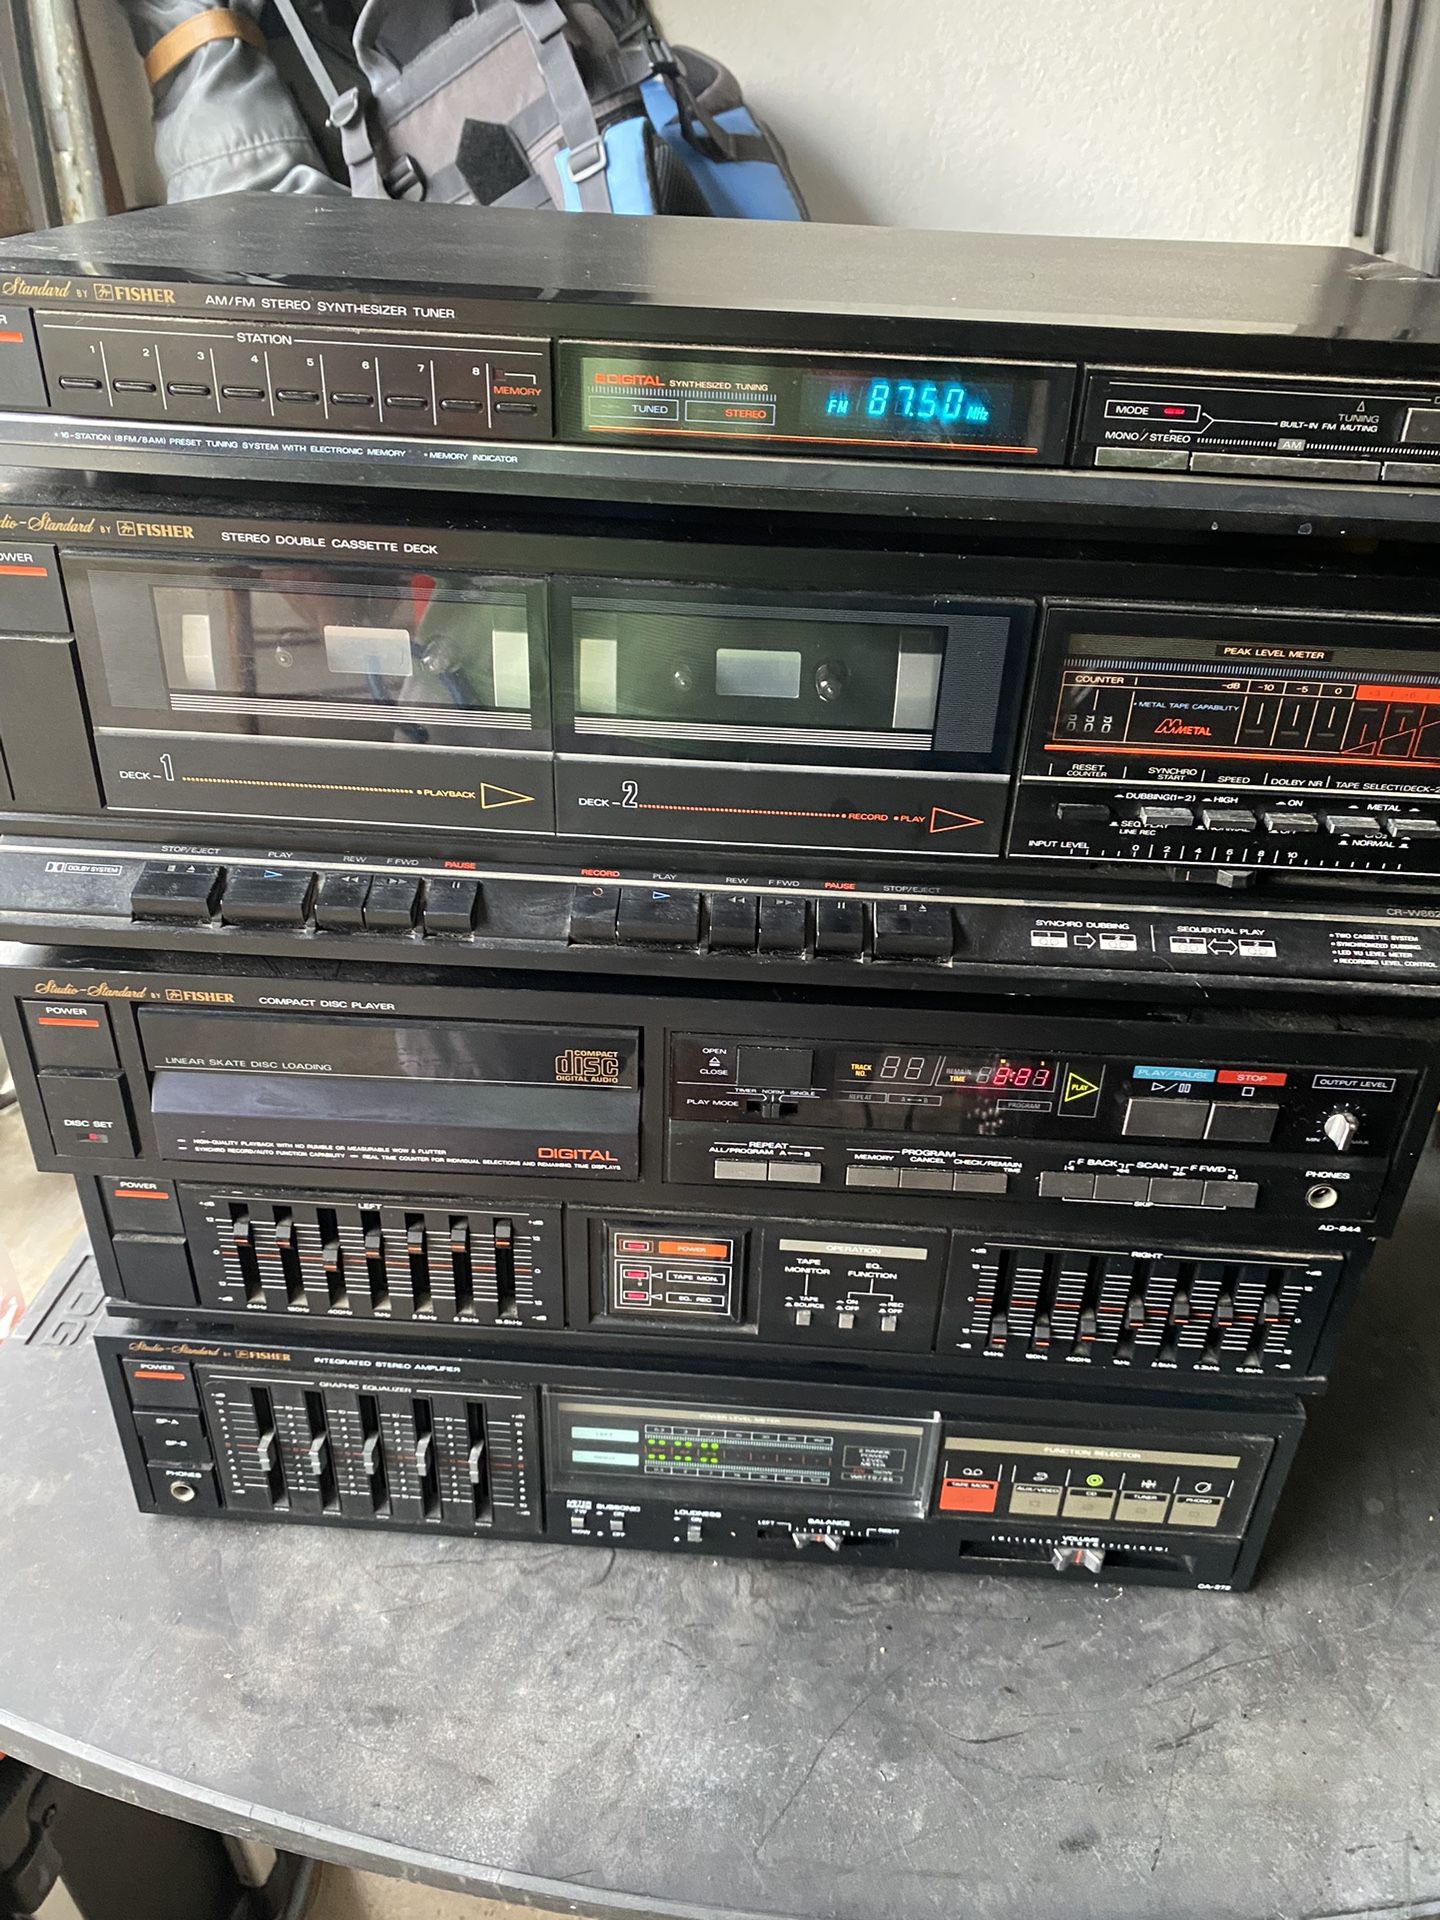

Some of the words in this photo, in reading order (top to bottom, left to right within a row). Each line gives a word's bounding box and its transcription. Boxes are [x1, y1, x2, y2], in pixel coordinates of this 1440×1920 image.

[76, 289, 87, 298] BY
[114, 286, 176, 304] FISHER
[205, 294, 255, 308] AM/FM
[261, 298, 311, 311] STEREO
[317, 301, 407, 317] SYNTHESIZER
[413, 307, 455, 319] TUNER
[237, 332, 292, 345] STATION
[90, 345, 96, 353] 1
[142, 348, 150, 357] 2
[197, 352, 205, 360] 3
[250, 355, 259, 363] 4
[306, 358, 314, 367] 5
[361, 360, 370, 370] 6
[417, 363, 425, 373] 7
[472, 366, 480, 376] 8
[606, 373, 665, 388] DIGITAL
[669, 379, 732, 390] SYNTHESIZED
[735, 383, 769, 392] TUNING
[493, 385, 542, 397] MEMORY
[868, 385, 965, 418] 87.50
[632, 404, 669, 415] TUNED
[725, 408, 767, 420] STEREO
[1115, 405, 1149, 416] MODE
[1338, 413, 1380, 424] TUNING
[1280, 420, 1319, 430] BUILT-IN
[1322, 422, 1337, 431] FM
[1340, 423, 1378, 433] MUTING
[1105, 429, 1191, 444] MONO/STEREO
[169, 438, 201, 447] PRESET
[205, 440, 238, 449] TUNING
[242, 441, 279, 451] SYSTEM
[282, 444, 306, 452] WITH
[310, 445, 363, 456] ELECTRONIC
[367, 448, 406, 457] MEMORY
[1282, 440, 1302, 450] AM
[430, 451, 468, 461] MEMORY
[473, 453, 518, 464] INDICATOR
[0, 512, 95, 534] dio-Standard
[100, 525, 111, 534] BY
[136, 523, 194, 539] FISHER
[221, 532, 271, 544] STEREO
[275, 535, 326, 548] DOUBLE
[331, 539, 399, 552] CASSETTE
[403, 543, 439, 555] DECK
[0, 552, 33, 563] OWER
[1224, 647, 1252, 657] PEAK
[1255, 649, 1286, 658] LEVEL
[1289, 650, 1325, 660] METER
[1075, 675, 1124, 685] COUNTER
[1192, 703, 1240, 711] CAPABILITY
[1072, 764, 1105, 772] RESET
[1148, 767, 1198, 776] SYNCHRO
[1066, 770, 1108, 778] COUNTER
[1157, 773, 1186, 781] START
[1217, 775, 1251, 784] SPEED
[1271, 778, 1304, 787] DOLBY
[1308, 780, 1324, 788] NR
[1335, 781, 1360, 790] TAPE
[423, 789, 476, 800] PLAYBACK
[1214, 796, 1239, 804] HIGH
[1288, 799, 1304, 807] ON
[1367, 804, 1401, 812] METAL
[849, 813, 888, 821] RECORD
[901, 815, 926, 823] PLAY
[1028, 840, 1058, 848] INPUT
[1061, 841, 1090, 849] LEVEL
[1352, 840, 1395, 848] NORMAL
[161, 845, 221, 855] STOP/EJECT
[343, 855, 367, 863] REW
[444, 861, 476, 870] PAUSE
[581, 869, 620, 878] RECORD
[726, 877, 749, 885] REW
[824, 882, 856, 890] PAUSE
[883, 885, 941, 894] STOP/EJECT
[1036, 919, 1083, 928] SYNCHRO
[1086, 922, 1130, 930] DUBBING
[1177, 925, 1237, 935] SEQUENTIAL
[1239, 928, 1266, 936] PLAY
[34, 980, 148, 999] Studio-Standard
[182, 992, 235, 1003] FISHER
[258, 997, 316, 1007] COMPACT
[320, 1000, 348, 1009] DISC
[351, 1002, 396, 1011] PLAYER
[45, 1006, 88, 1016] POWER
[574, 1050, 619, 1058] COMPACT
[166, 1057, 205, 1066] LINEAR
[209, 1058, 247, 1068] SKATE
[251, 1060, 278, 1070] DISC
[282, 1062, 332, 1072] LOADING
[555, 1050, 619, 1078] disc
[851, 1063, 872, 1071] TRACK
[556, 1074, 589, 1082] DIGITAL
[591, 1076, 619, 1084] AUDIO
[1138, 1069, 1210, 1080] PLAY/PAUSE
[1237, 1074, 1268, 1082] STOP
[1320, 1079, 1358, 1087] OUTPUT
[1360, 1081, 1388, 1089] LEVEL
[64, 1119, 90, 1127] DISC
[93, 1121, 114, 1129] SET
[749, 1141, 789, 1150] REPEAT
[538, 1147, 619, 1162] DIGITAL
[709, 1146, 774, 1156] ALL/PROGRAM
[902, 1149, 957, 1158] PROGRAM
[854, 1154, 895, 1162] MEMORY
[910, 1156, 946, 1165] CANCEL
[1136, 1162, 1169, 1170] SCAN
[1305, 1170, 1351, 1180] PHONES
[120, 1181, 157, 1190] POWER
[826, 1245, 881, 1255] OPERATION
[1131, 1252, 1163, 1260] RIGHT
[796, 1258, 822, 1266] TAPE
[785, 1266, 831, 1275] MONITOR
[848, 1271, 898, 1280] FUNCTION
[250, 1352, 291, 1361] FISHER
[314, 1357, 371, 1367] INTEGRATED
[375, 1361, 411, 1370] STEREO
[414, 1364, 461, 1373] AMPLIFIER
[319, 1381, 360, 1390] GRAPHIC
[362, 1384, 412, 1393] EQUALIZER
[1044, 1447, 1092, 1456] FUNCTION
[1095, 1451, 1141, 1459] SELECTOR
[166, 1470, 202, 1479] PHONES
[674, 1509, 722, 1518] LOUDNESS
[808, 1518, 850, 1527] BALANCE
